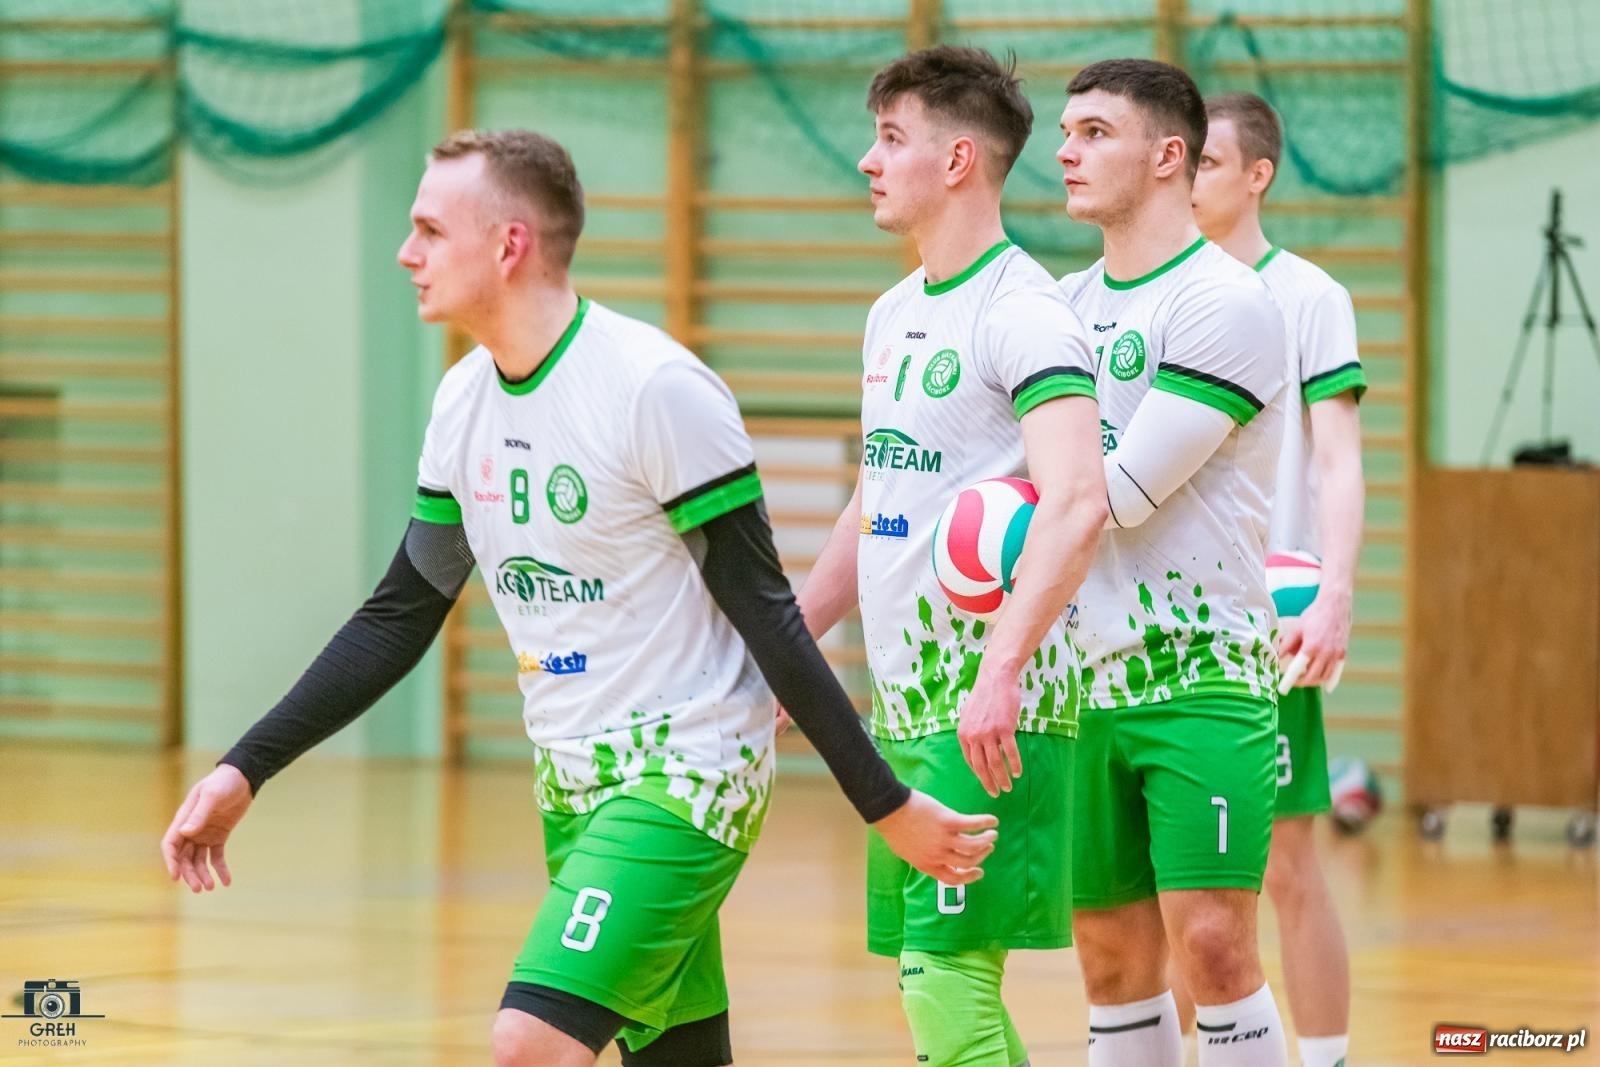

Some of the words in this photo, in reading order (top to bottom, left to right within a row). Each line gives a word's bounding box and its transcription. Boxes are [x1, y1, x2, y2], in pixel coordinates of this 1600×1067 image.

[510, 468, 530, 524] 8
[1210, 796, 1228, 854] 1
[561, 886, 612, 953] 8
